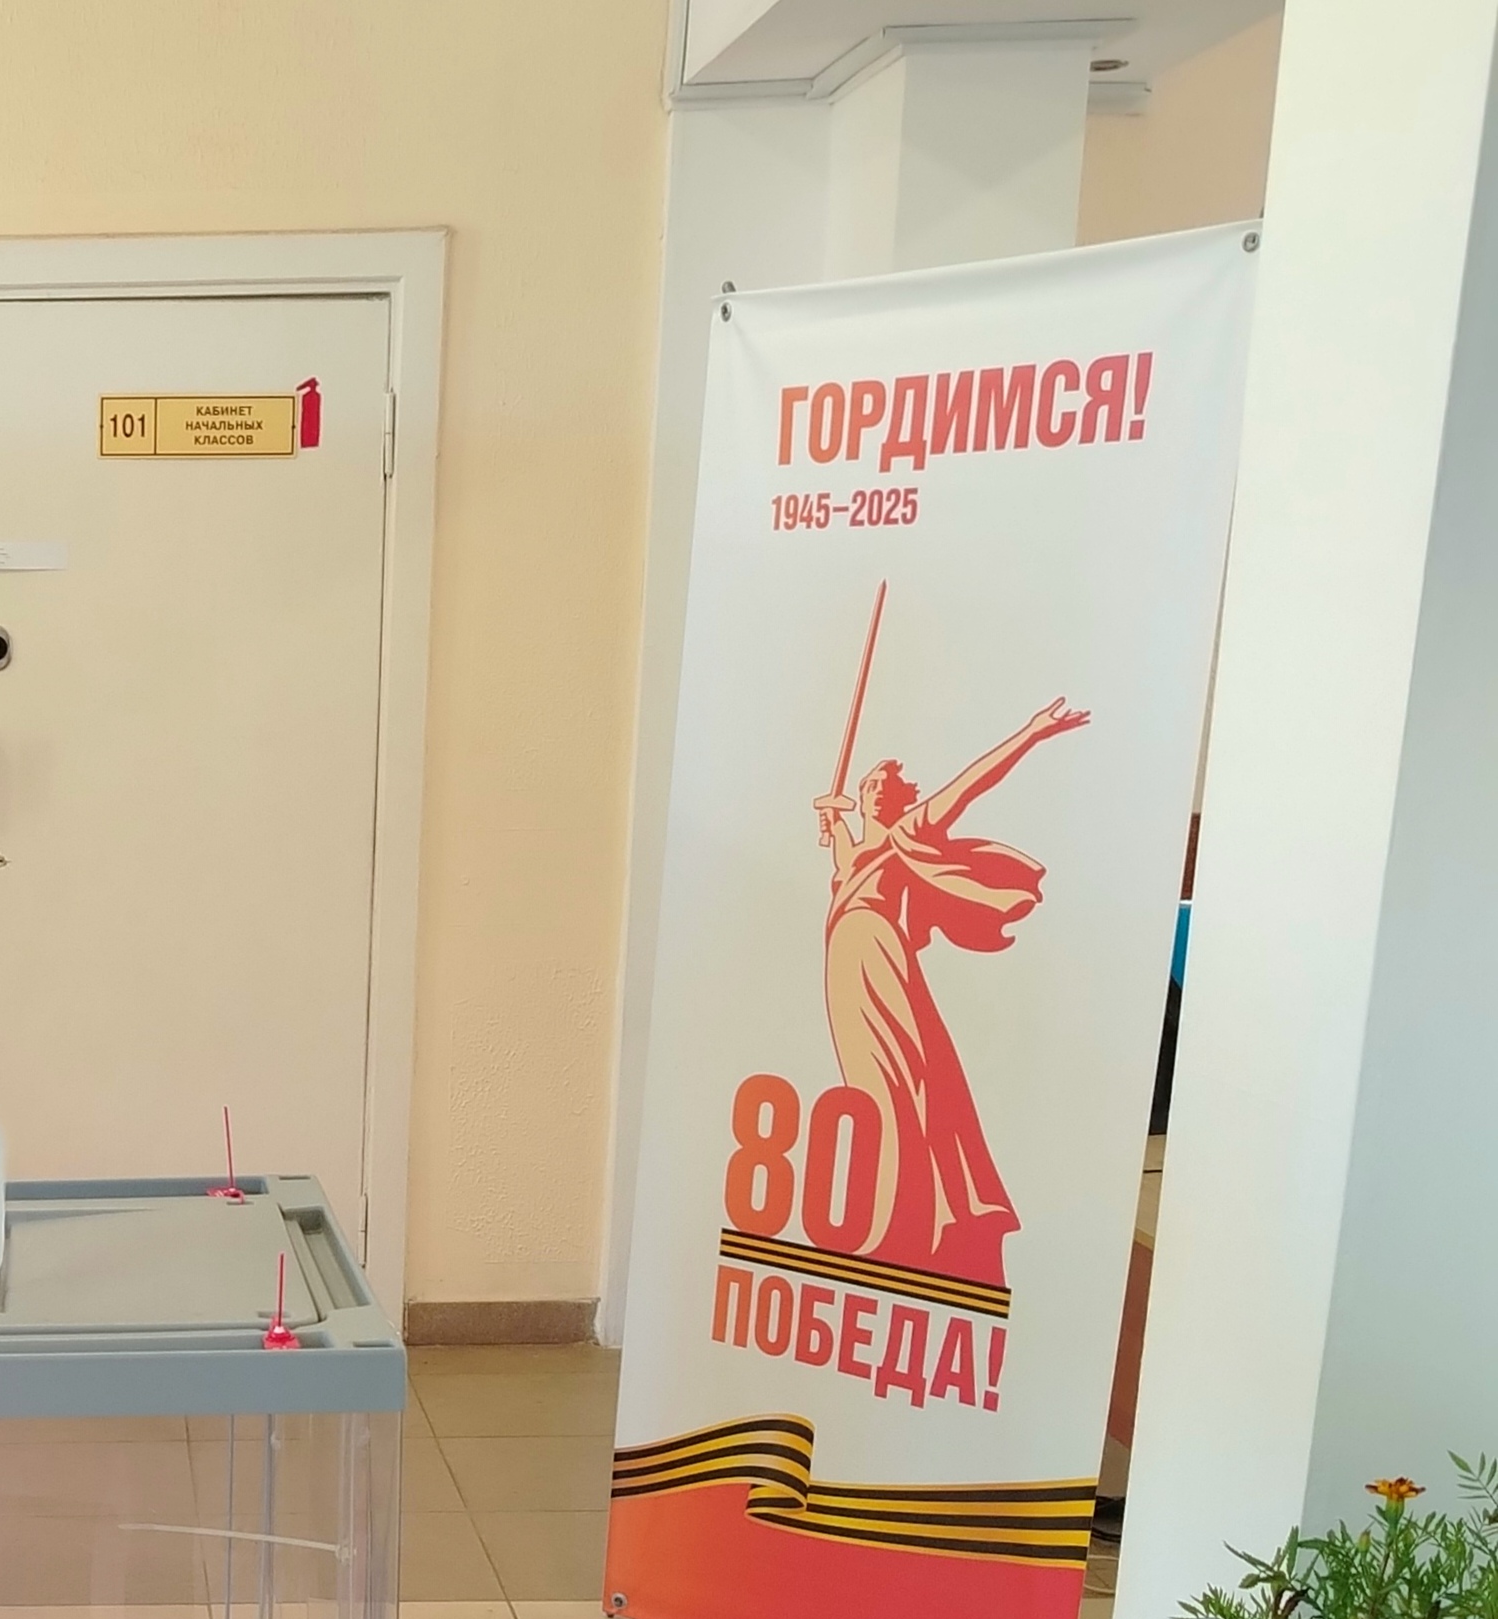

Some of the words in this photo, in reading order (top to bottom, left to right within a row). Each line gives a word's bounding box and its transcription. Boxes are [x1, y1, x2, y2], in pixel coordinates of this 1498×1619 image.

[196, 406, 253, 416] КАБИНЕТ
[777, 351, 1154, 473] ГОРДИМСЯ!
[109, 413, 146, 438] 101
[185, 420, 263, 431] НАЧАЛЬНЫХ
[194, 435, 254, 445] КЛАССОВ
[724, 1073, 883, 1255] 80
[711, 1264, 1007, 1413] ПОБЕДА!
